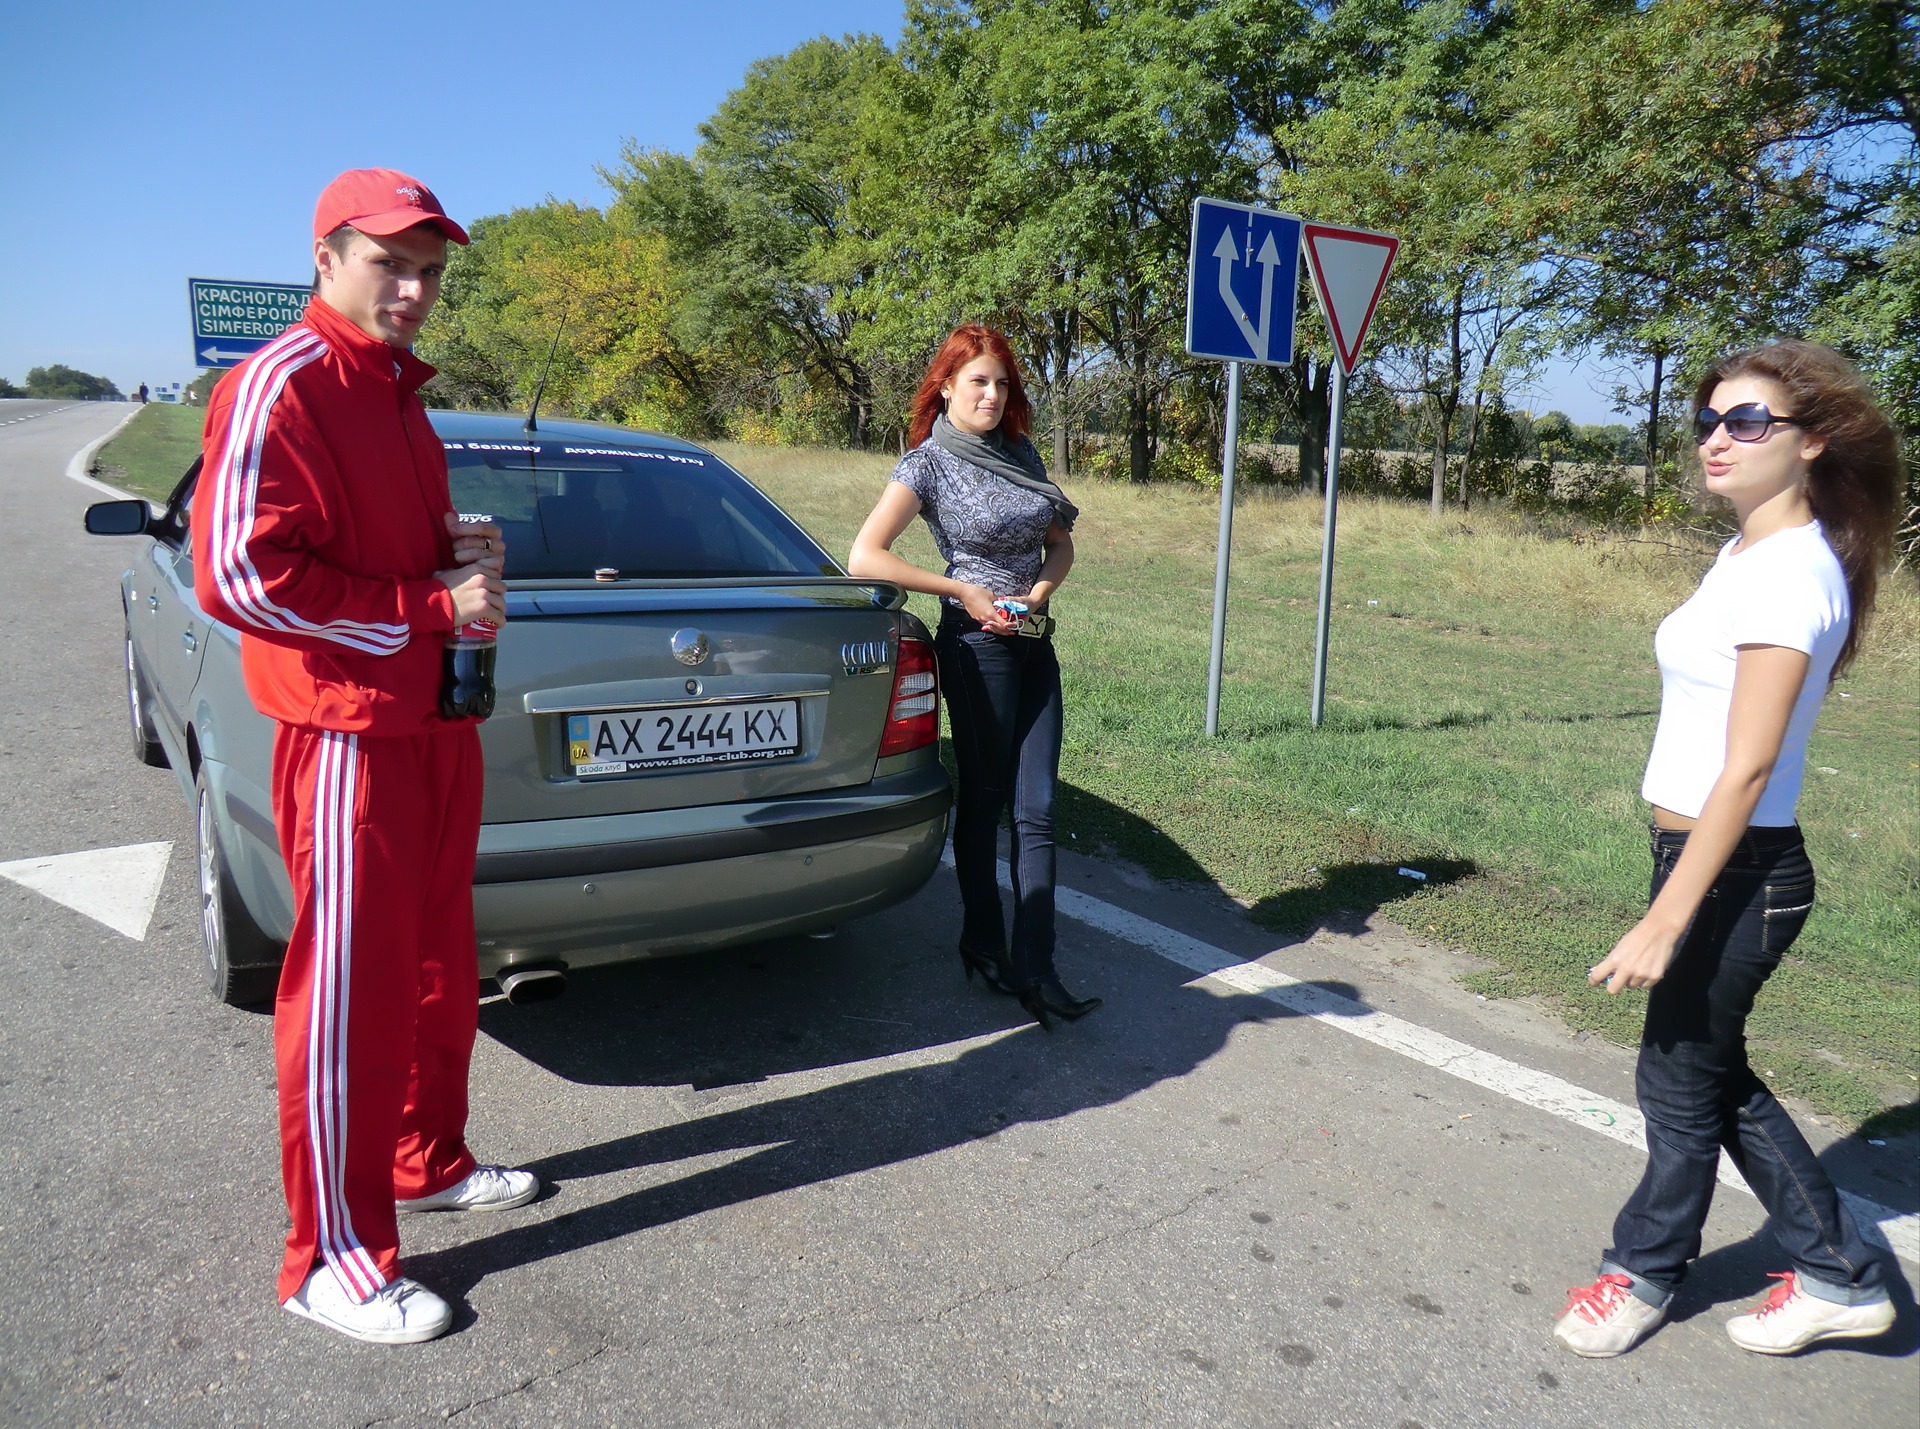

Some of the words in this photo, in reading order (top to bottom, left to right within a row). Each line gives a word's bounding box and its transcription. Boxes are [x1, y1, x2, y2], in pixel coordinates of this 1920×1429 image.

[197, 287, 310, 308] КРАСНОГРАД
[200, 303, 304, 322] СІМФЕРОПО
[468, 442, 541, 453] безпеку
[564, 446, 666, 460] дорожнього
[668, 454, 705, 467] руху
[594, 718, 644, 757] AX
[656, 712, 734, 752] 2444
[744, 708, 788, 744] KX
[572, 744, 589, 759] UA
[628, 748, 795, 770] www.skoda-club.org.ua
